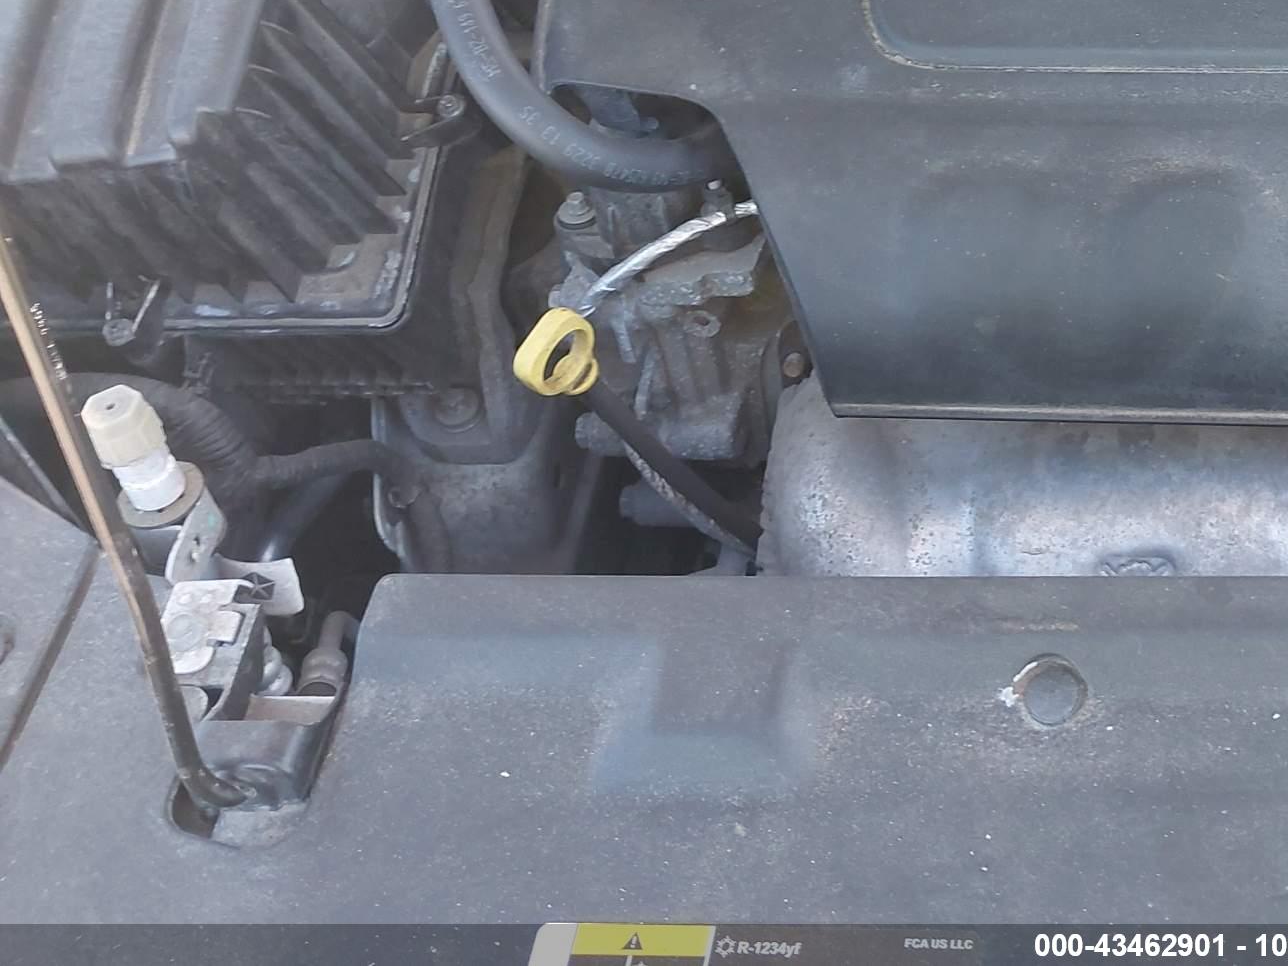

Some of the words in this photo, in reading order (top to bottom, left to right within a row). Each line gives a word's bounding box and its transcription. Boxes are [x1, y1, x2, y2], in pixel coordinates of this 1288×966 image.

[736, 941, 803, 958] R-1234yf
[903, 937, 929, 949] FCA
[930, 938, 948, 950] US
[949, 938, 974, 950] LLC
